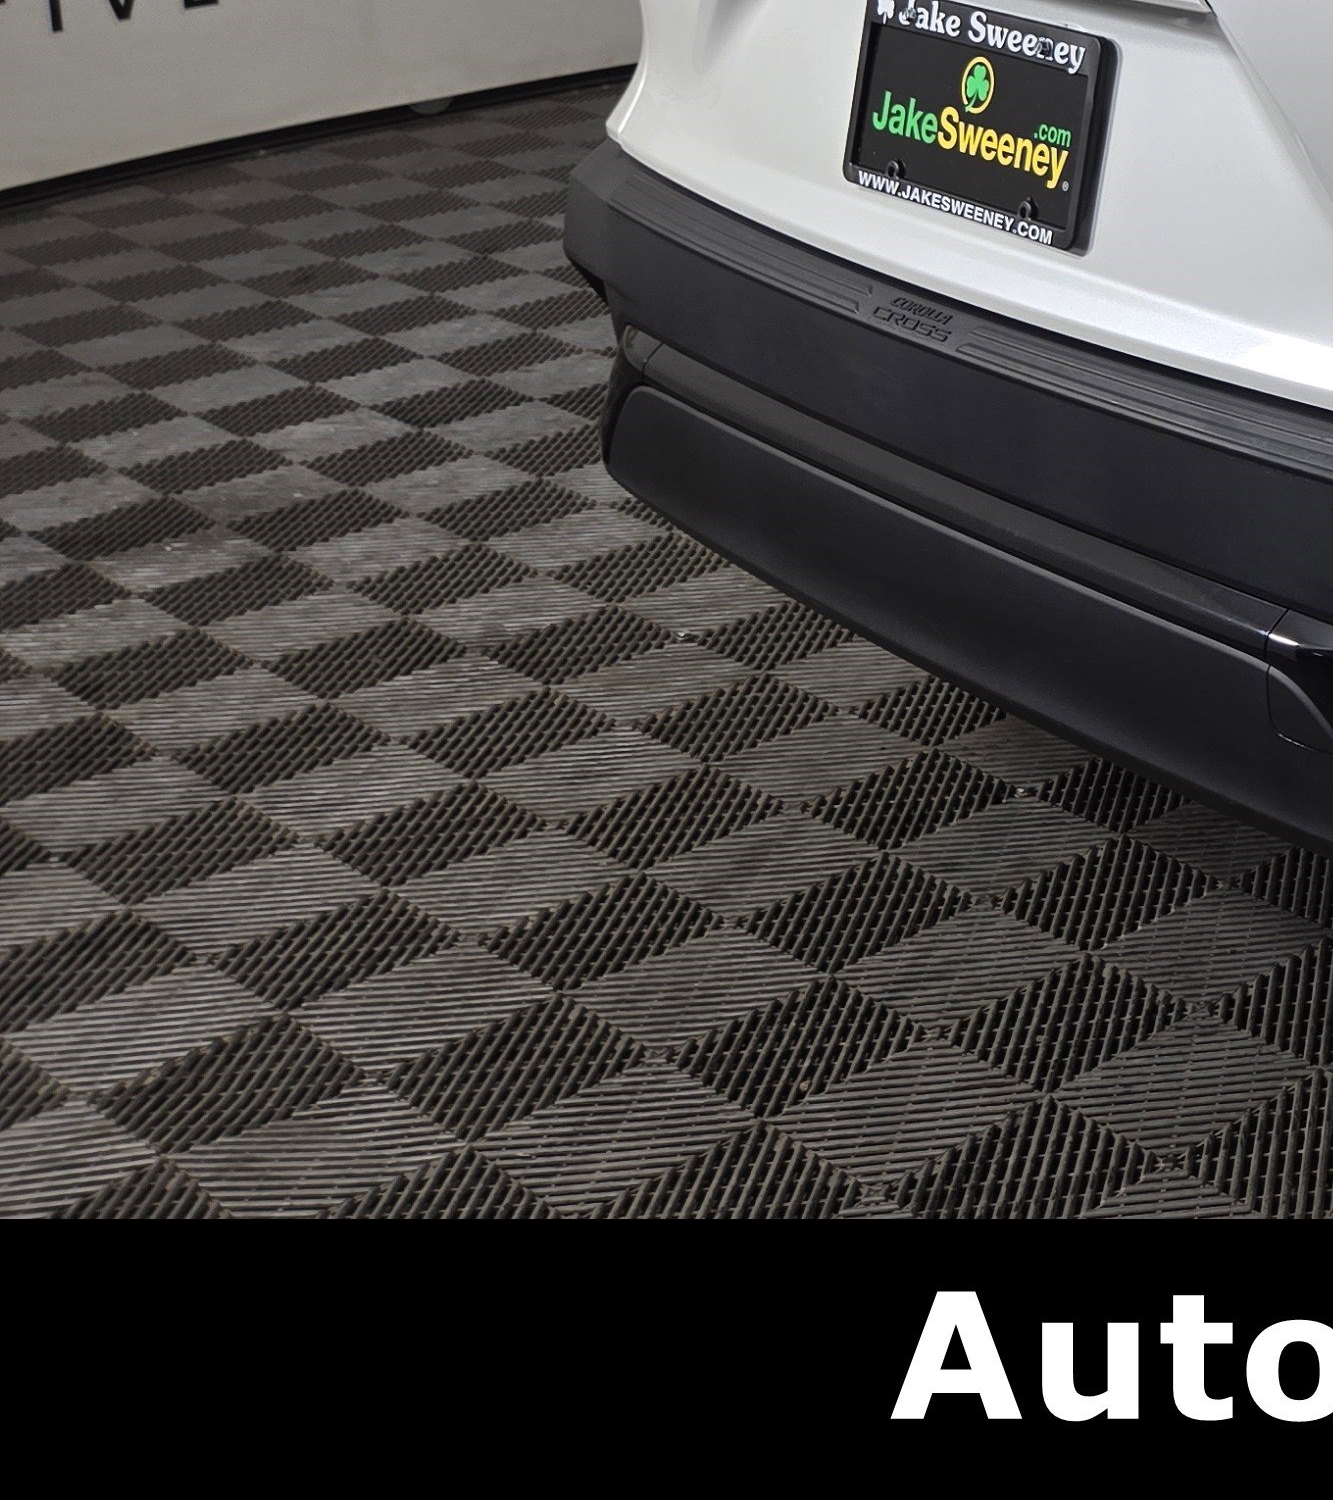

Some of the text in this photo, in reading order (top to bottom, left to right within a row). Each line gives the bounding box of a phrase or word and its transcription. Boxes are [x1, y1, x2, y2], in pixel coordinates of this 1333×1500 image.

[967, 10, 1086, 75] Sweeney
[872, 90, 1070, 190] JakeSweeney
[1033, 121, 1072, 148] .com
[858, 169, 1053, 246] WWW.JAKESWEENEY.COM
[873, 306, 953, 342] CROSS
[890, 296, 954, 326] COROLLA
